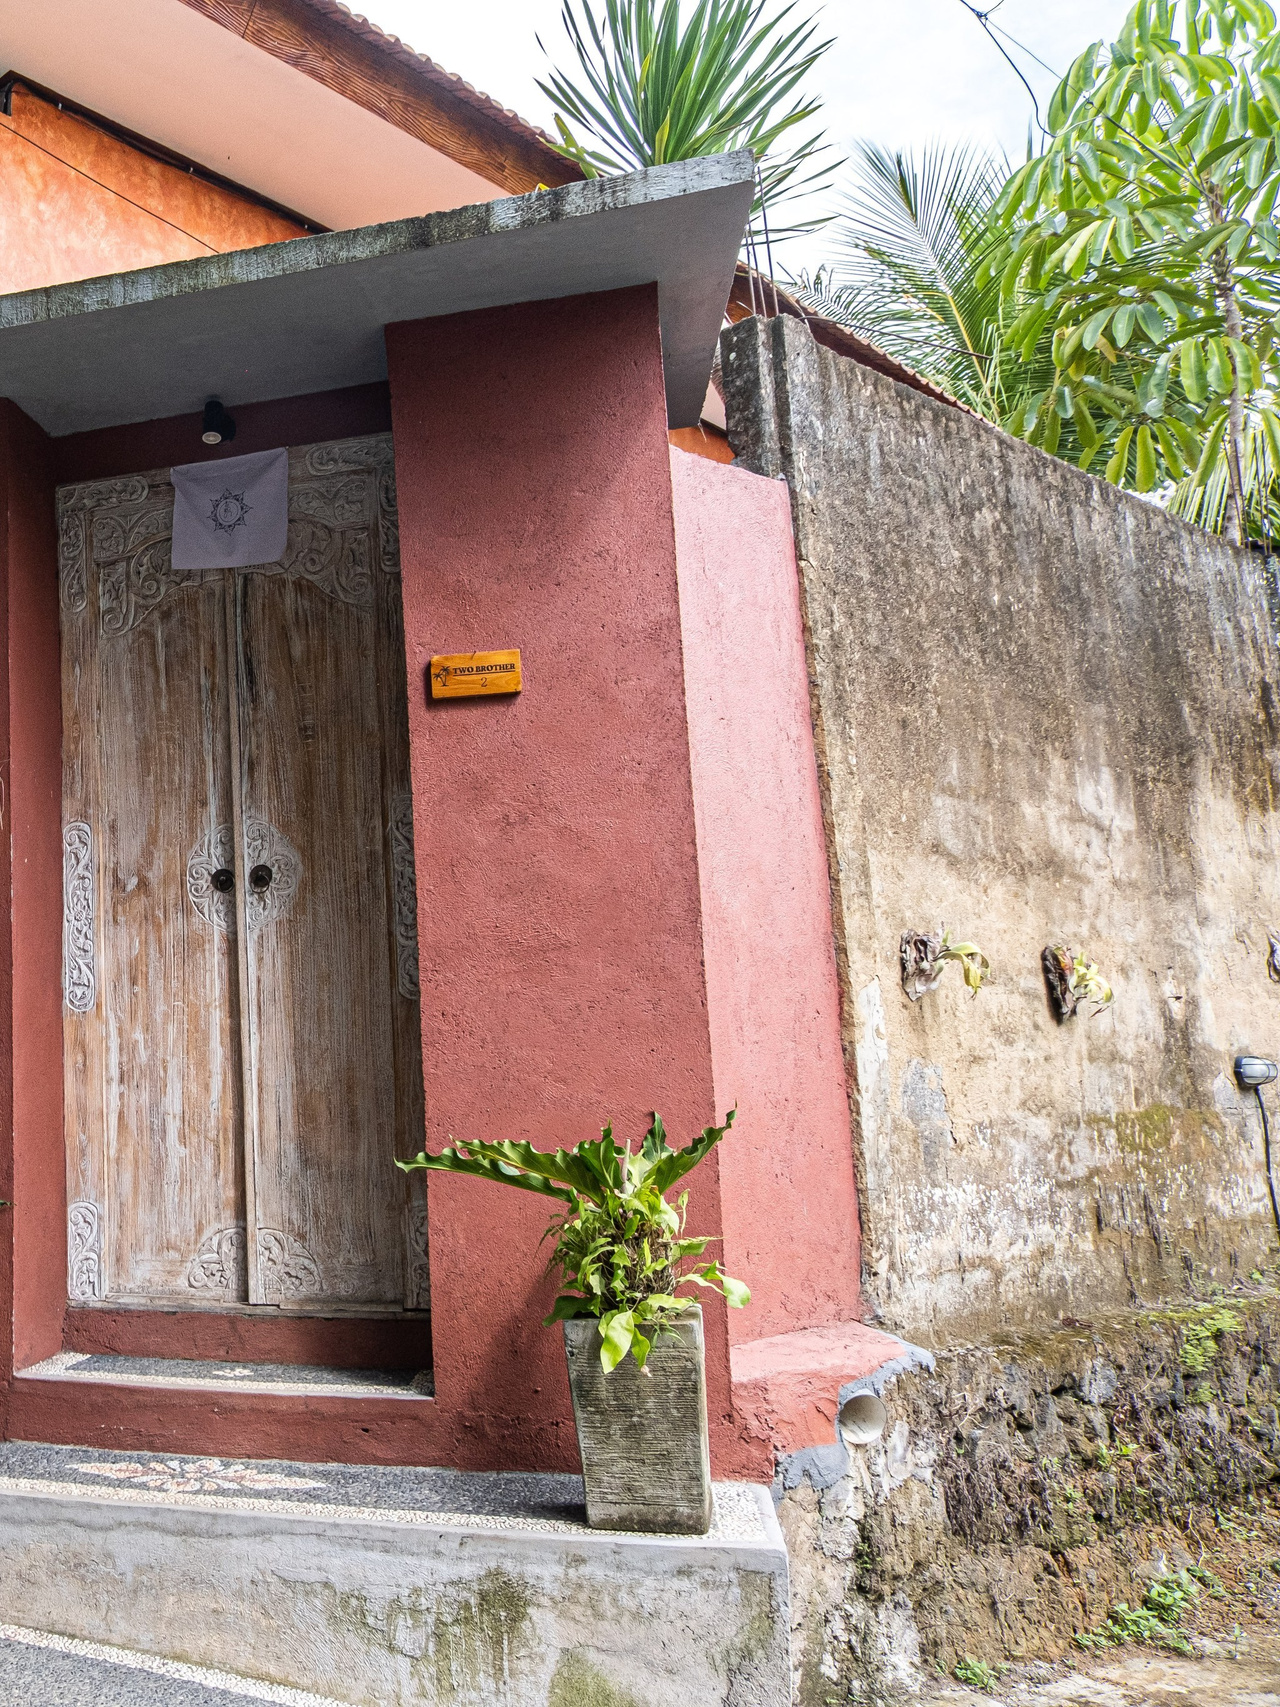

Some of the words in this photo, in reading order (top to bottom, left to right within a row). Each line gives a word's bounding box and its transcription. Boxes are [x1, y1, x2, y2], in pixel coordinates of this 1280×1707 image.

[452, 666, 474, 674] TWO
[475, 663, 516, 672] BROTHER
[480, 677, 488, 687] 2
